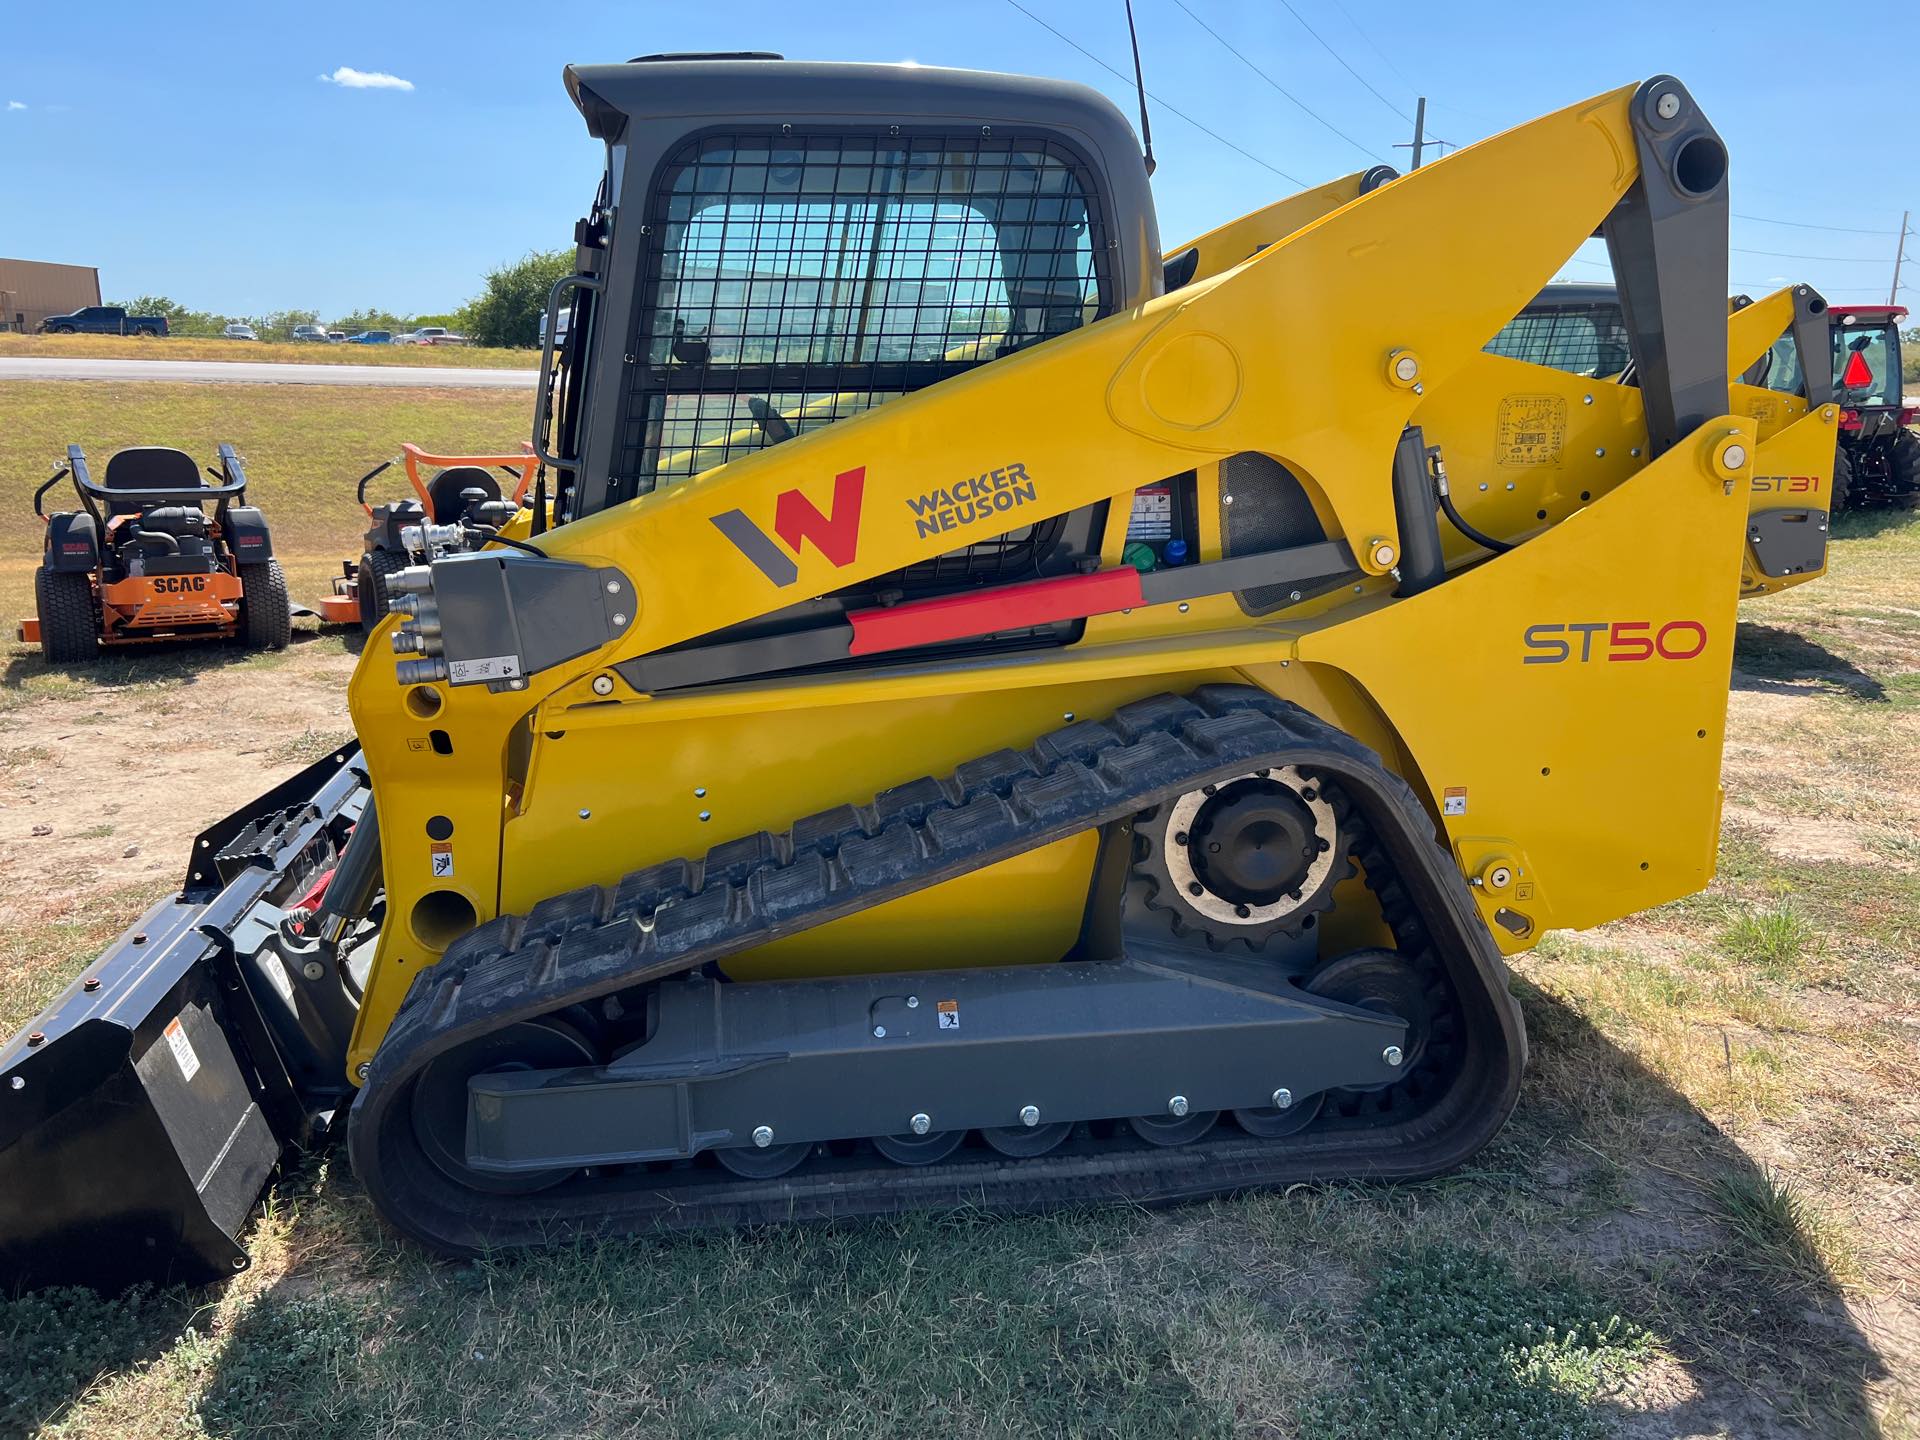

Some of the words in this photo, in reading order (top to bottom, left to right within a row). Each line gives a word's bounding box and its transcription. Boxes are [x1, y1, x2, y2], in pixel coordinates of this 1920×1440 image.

[906, 463, 1031, 517] WACKER
[1751, 477, 1819, 493] ST31
[915, 480, 1037, 540] NEUSON
[154, 577, 205, 594] SCAG
[1523, 620, 1708, 664] ST50
